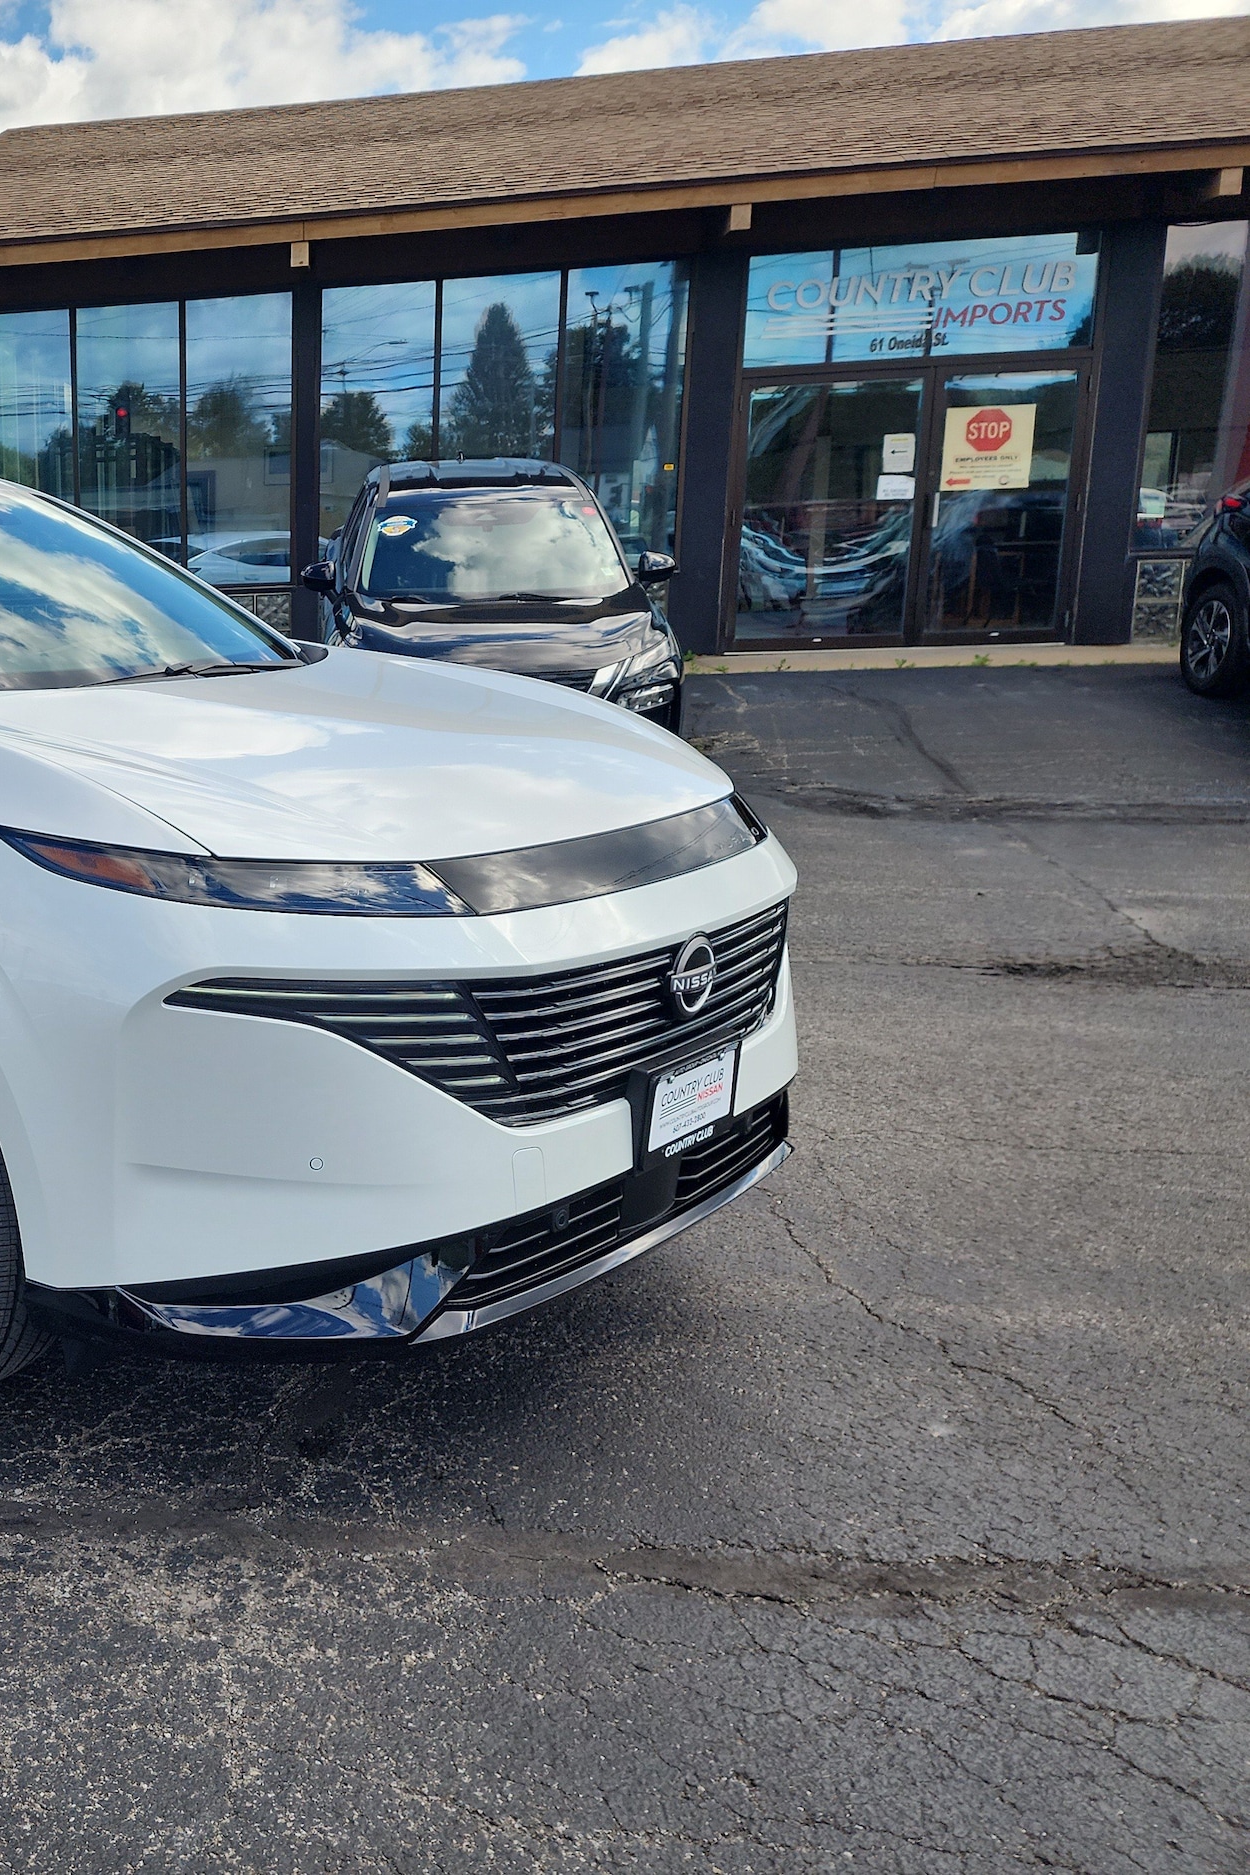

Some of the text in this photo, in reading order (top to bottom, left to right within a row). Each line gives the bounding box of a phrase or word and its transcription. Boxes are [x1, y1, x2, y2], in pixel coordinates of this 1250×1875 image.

[767, 260, 1078, 312] COUNTRY CLUB
[932, 298, 1067, 329] IMPORTS
[870, 337, 884, 353] 61
[968, 422, 1011, 440] STOP
[955, 455, 998, 463] EMPLOYEES
[672, 970, 713, 991] NISSA
[661, 1067, 725, 1107] COUNTRY CLUB
[696, 1082, 724, 1102] NISSAN
[664, 1124, 715, 1158] COUNTRY CLUB
